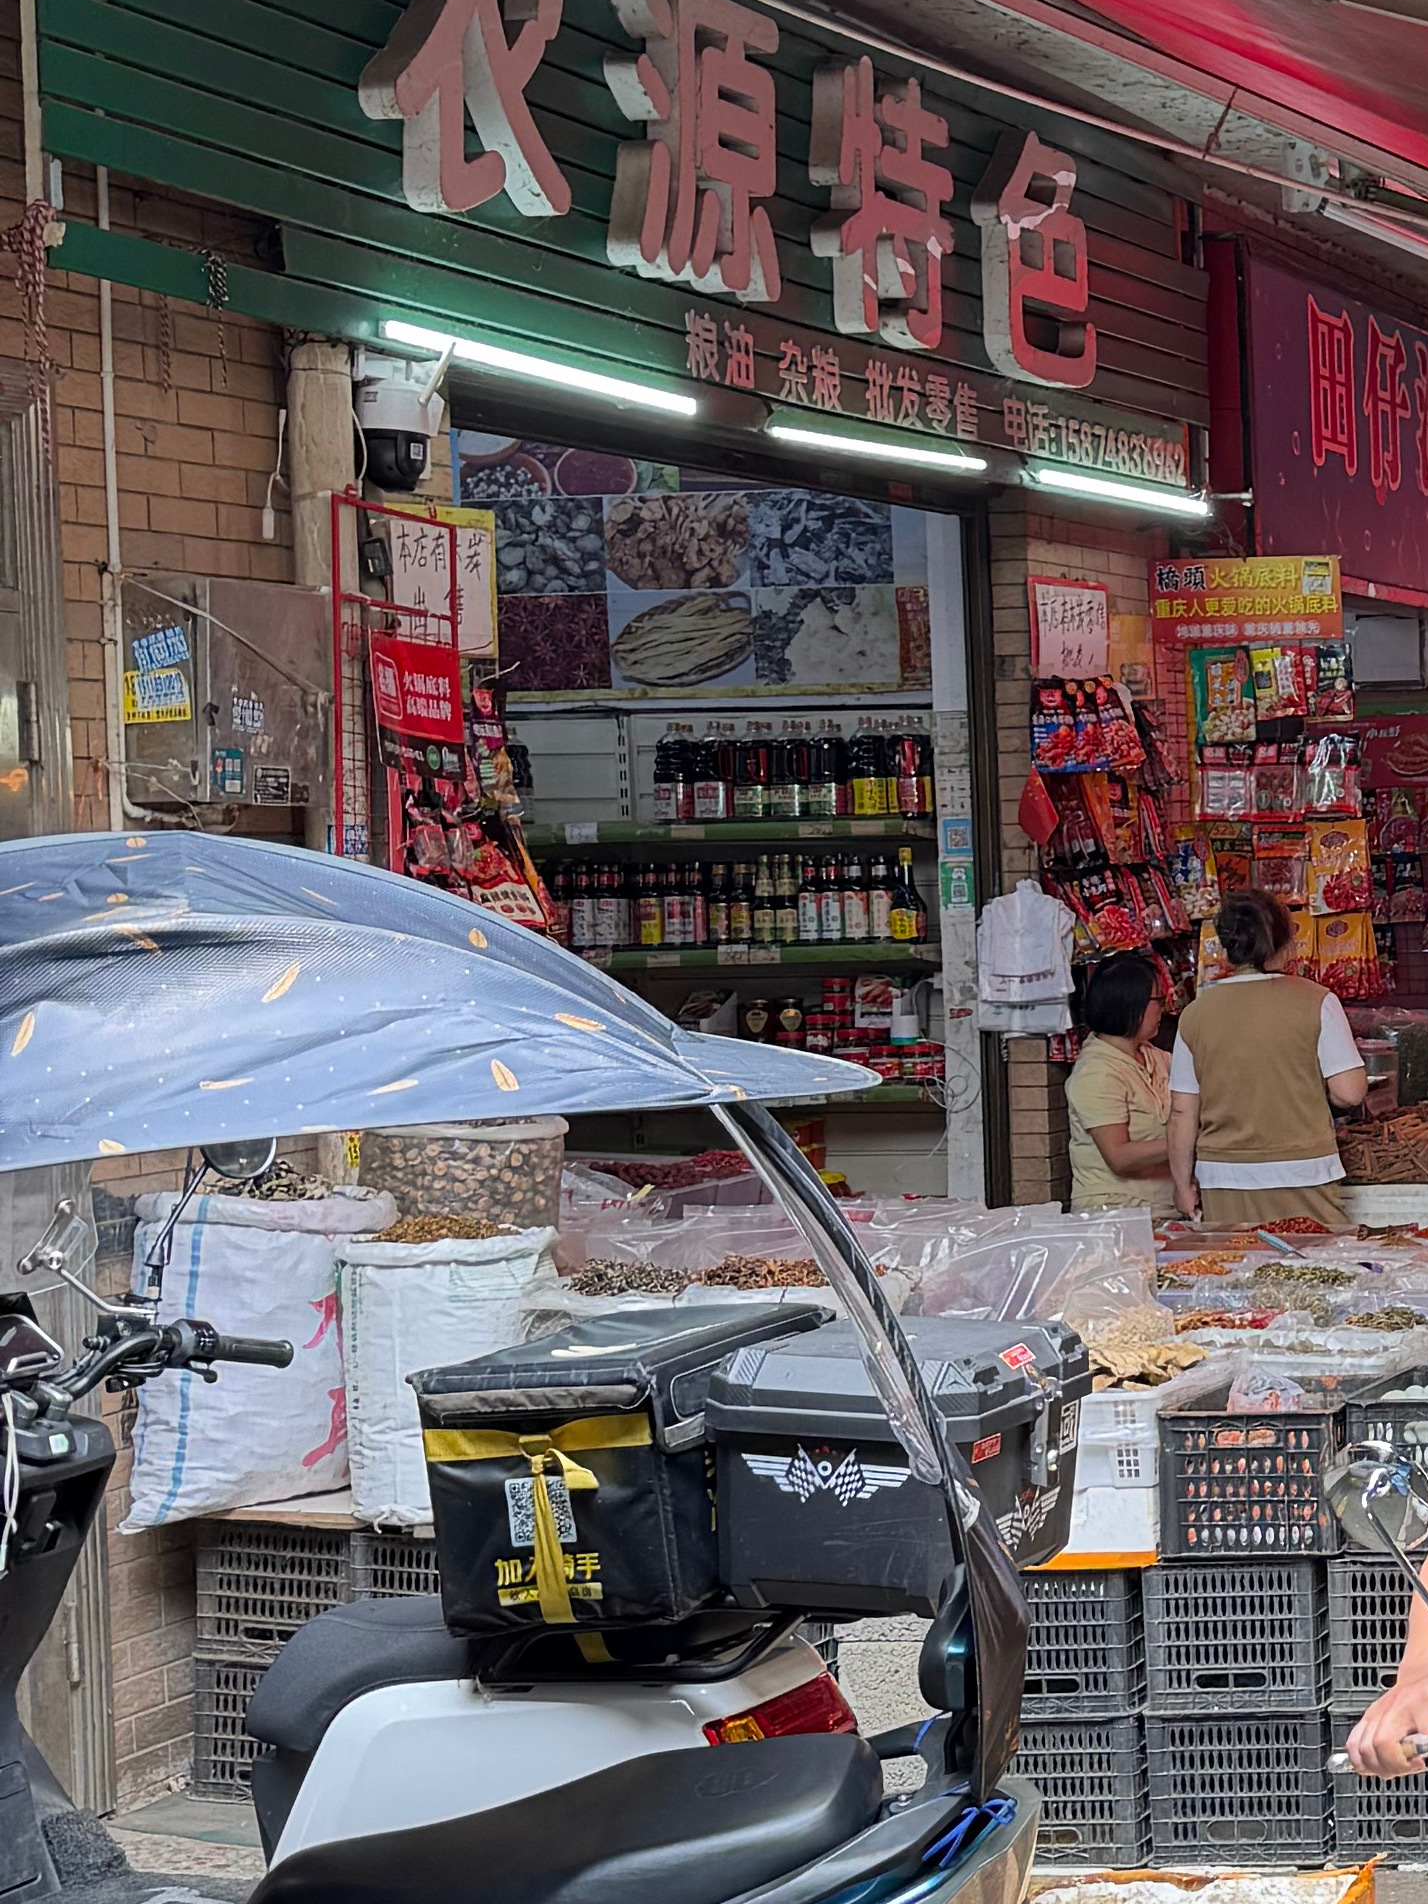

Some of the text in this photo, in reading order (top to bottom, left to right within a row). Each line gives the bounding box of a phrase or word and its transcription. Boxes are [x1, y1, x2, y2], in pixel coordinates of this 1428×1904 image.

[684, 309, 755, 390] 粮油
[778, 339, 840, 410] 杂粮
[865, 358, 979, 441] 批发零售
[1209, 562, 1299, 590] 火锅底料
[1155, 595, 1338, 619] 重庆人更爱吃的火锅底料
